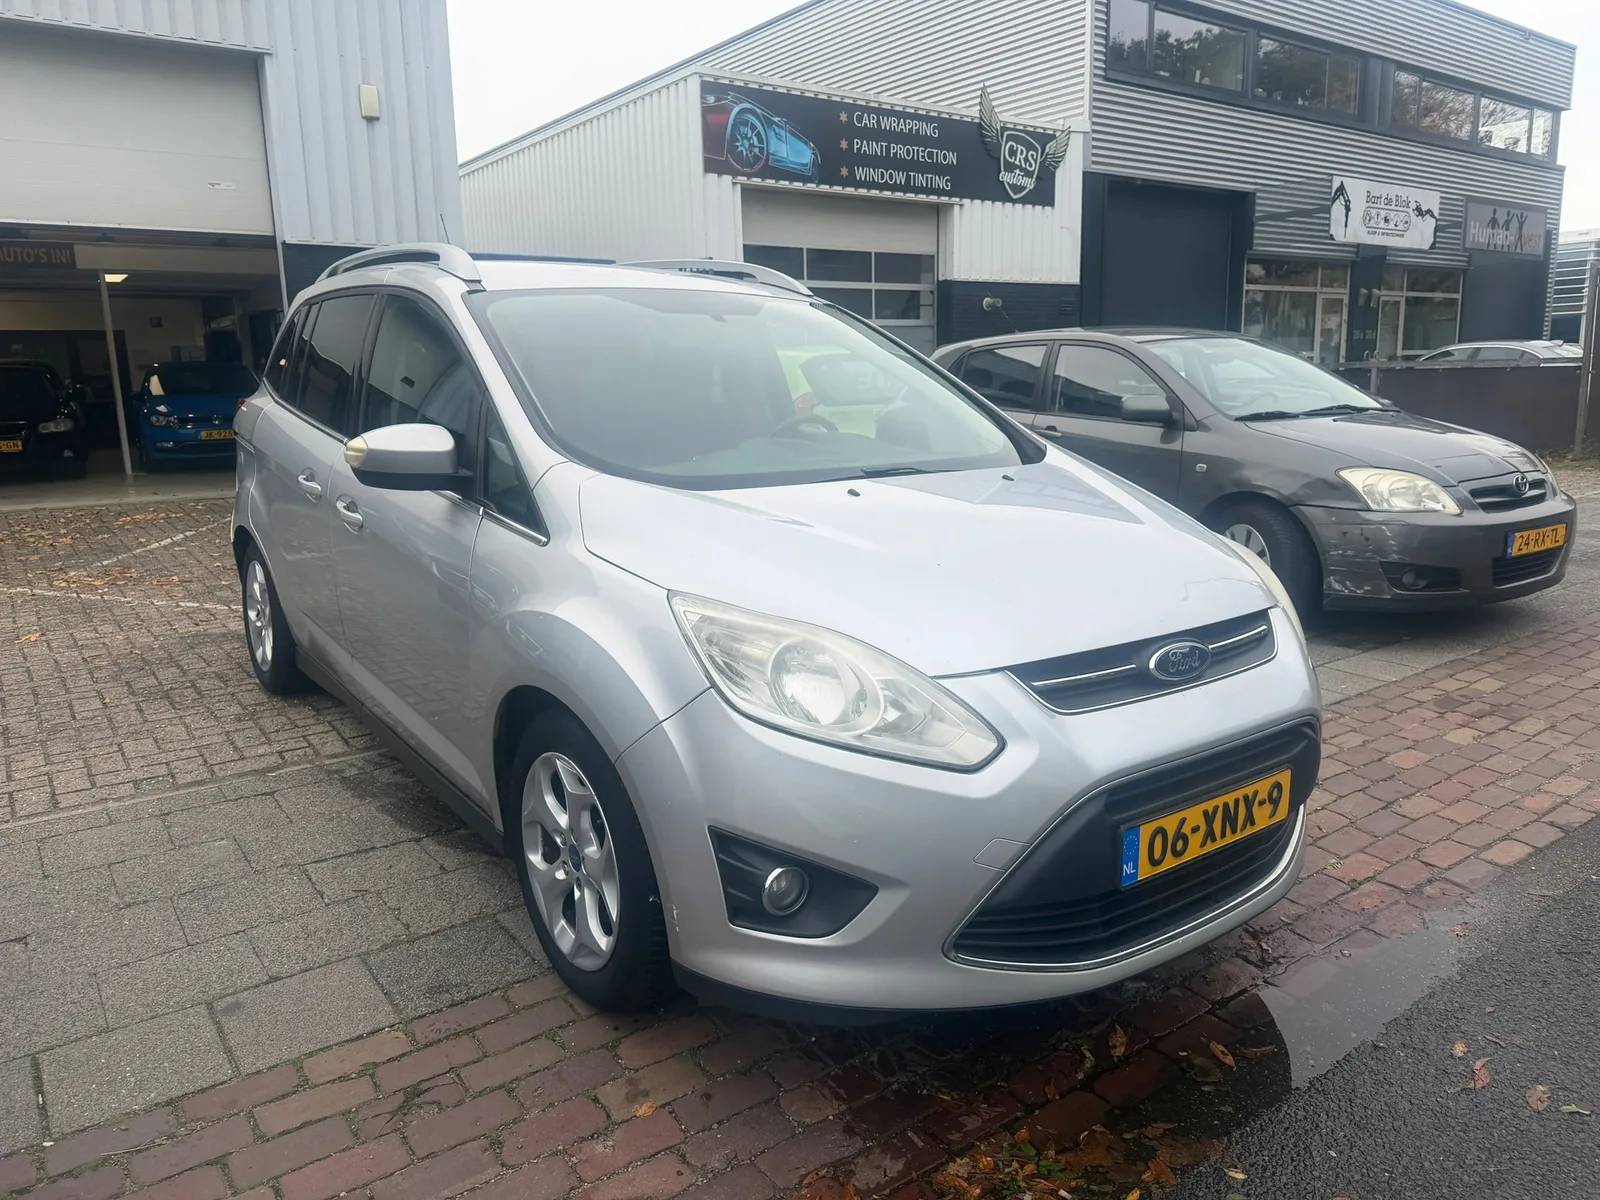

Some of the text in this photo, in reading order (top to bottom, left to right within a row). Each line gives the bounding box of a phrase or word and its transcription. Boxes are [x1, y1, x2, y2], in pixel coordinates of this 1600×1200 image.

[853, 111, 939, 138] CAR WRAPPING
[853, 138, 957, 165] PAINT PROTECTION
[1005, 141, 1037, 171] CRS
[854, 166, 951, 190] WINDOW TINTING
[999, 168, 1037, 189] customs
[1365, 190, 1411, 208] Bart de Blok
[50, 247, 72, 264] IN!
[1517, 527, 1560, 552] 24-RX-TL
[1168, 647, 1201, 673] Ford
[1147, 780, 1283, 867] 06-XNX-9
[1122, 863, 1137, 877] NL
